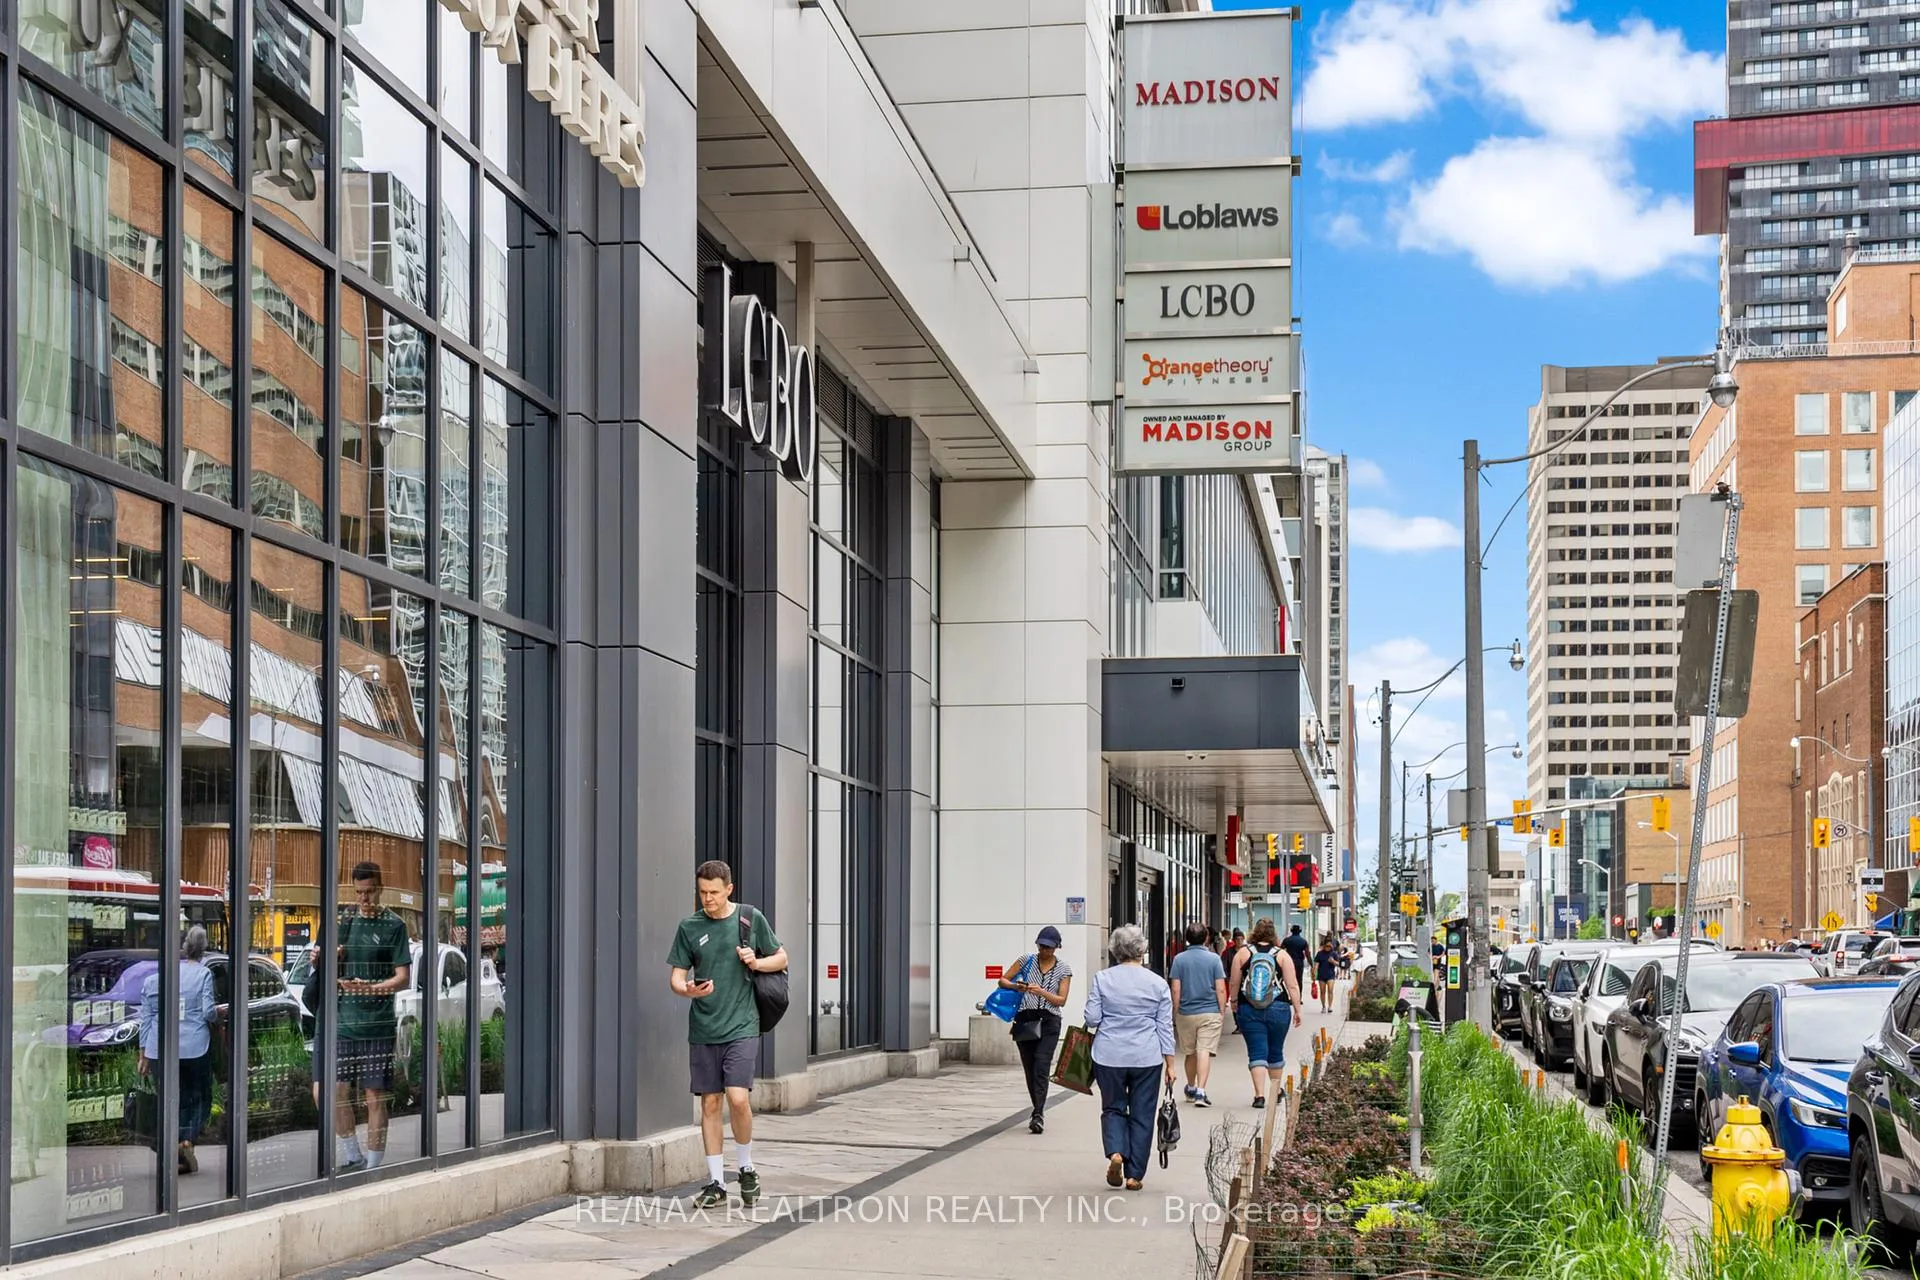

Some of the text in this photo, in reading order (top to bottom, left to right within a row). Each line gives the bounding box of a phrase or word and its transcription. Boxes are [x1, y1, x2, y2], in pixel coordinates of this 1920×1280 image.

[1135, 76, 1280, 106] MADISON
[1163, 203, 1279, 230] Loblaws
[1160, 283, 1255, 318] LCBO
[703, 262, 816, 482] LCBO
[1167, 376, 1268, 386] FITNESS
[1142, 420, 1272, 442] MADISON
[1223, 440, 1272, 452] GROUP
